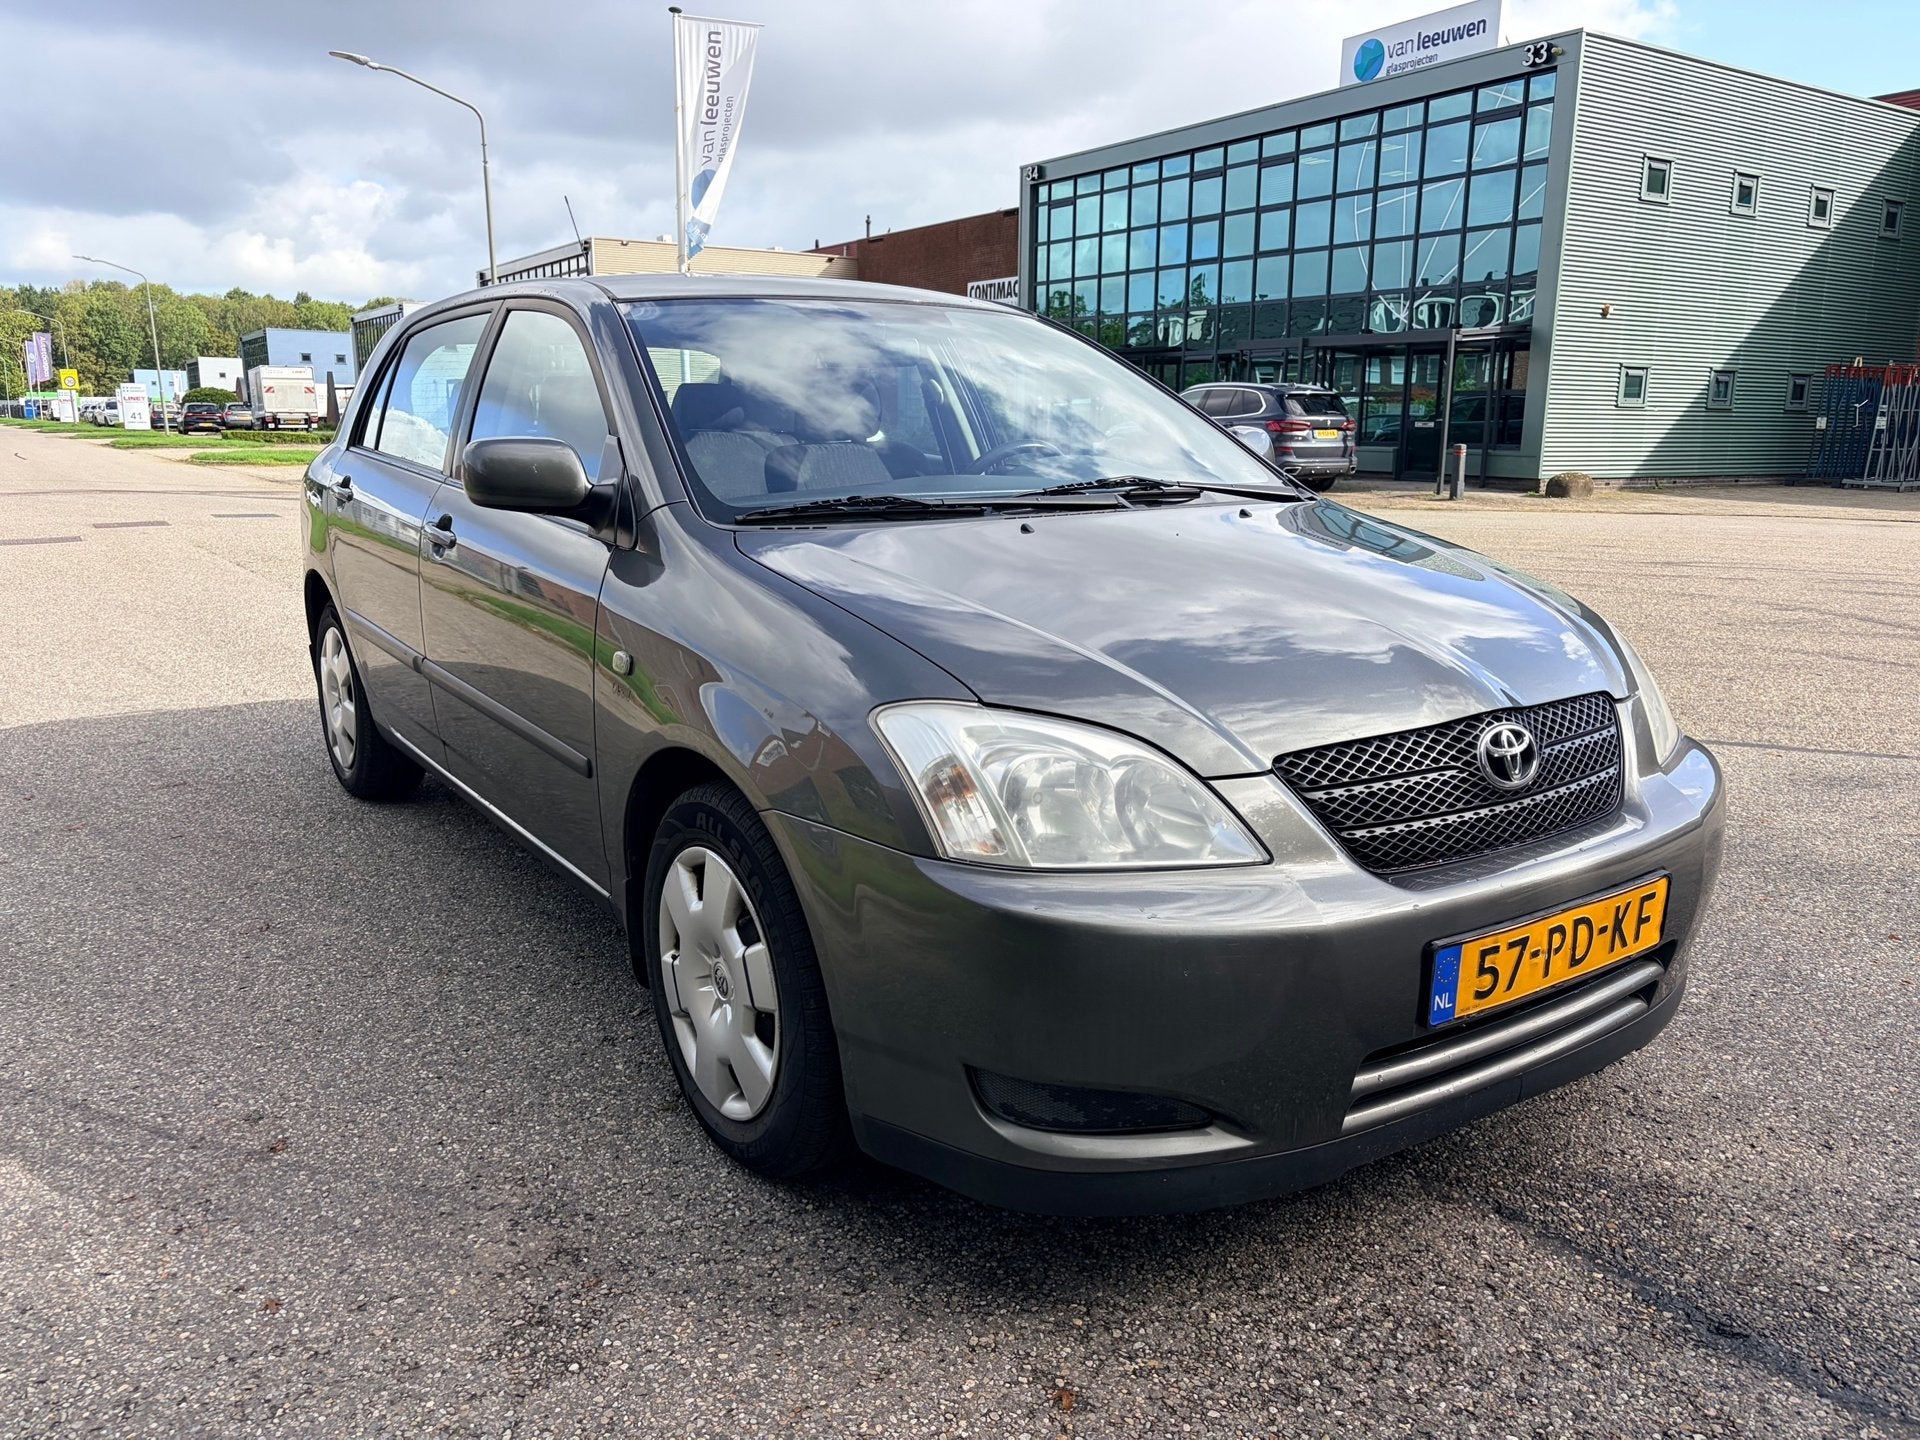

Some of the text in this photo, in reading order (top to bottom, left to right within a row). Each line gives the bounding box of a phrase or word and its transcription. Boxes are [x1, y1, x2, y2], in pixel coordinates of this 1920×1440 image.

[1387, 18, 1487, 58] van leeuwen
[1386, 52, 1438, 76] glasprojecten
[1522, 41, 1548, 67] 33
[700, 30, 722, 166] van leeuwen
[1026, 166, 1038, 180] 34
[970, 279, 1018, 300] CONTIMAC
[131, 412, 142, 420] 41
[696, 812, 723, 841] ALL
[1474, 892, 1657, 1000] 57-PD-KF
[1434, 992, 1452, 1011] NL
